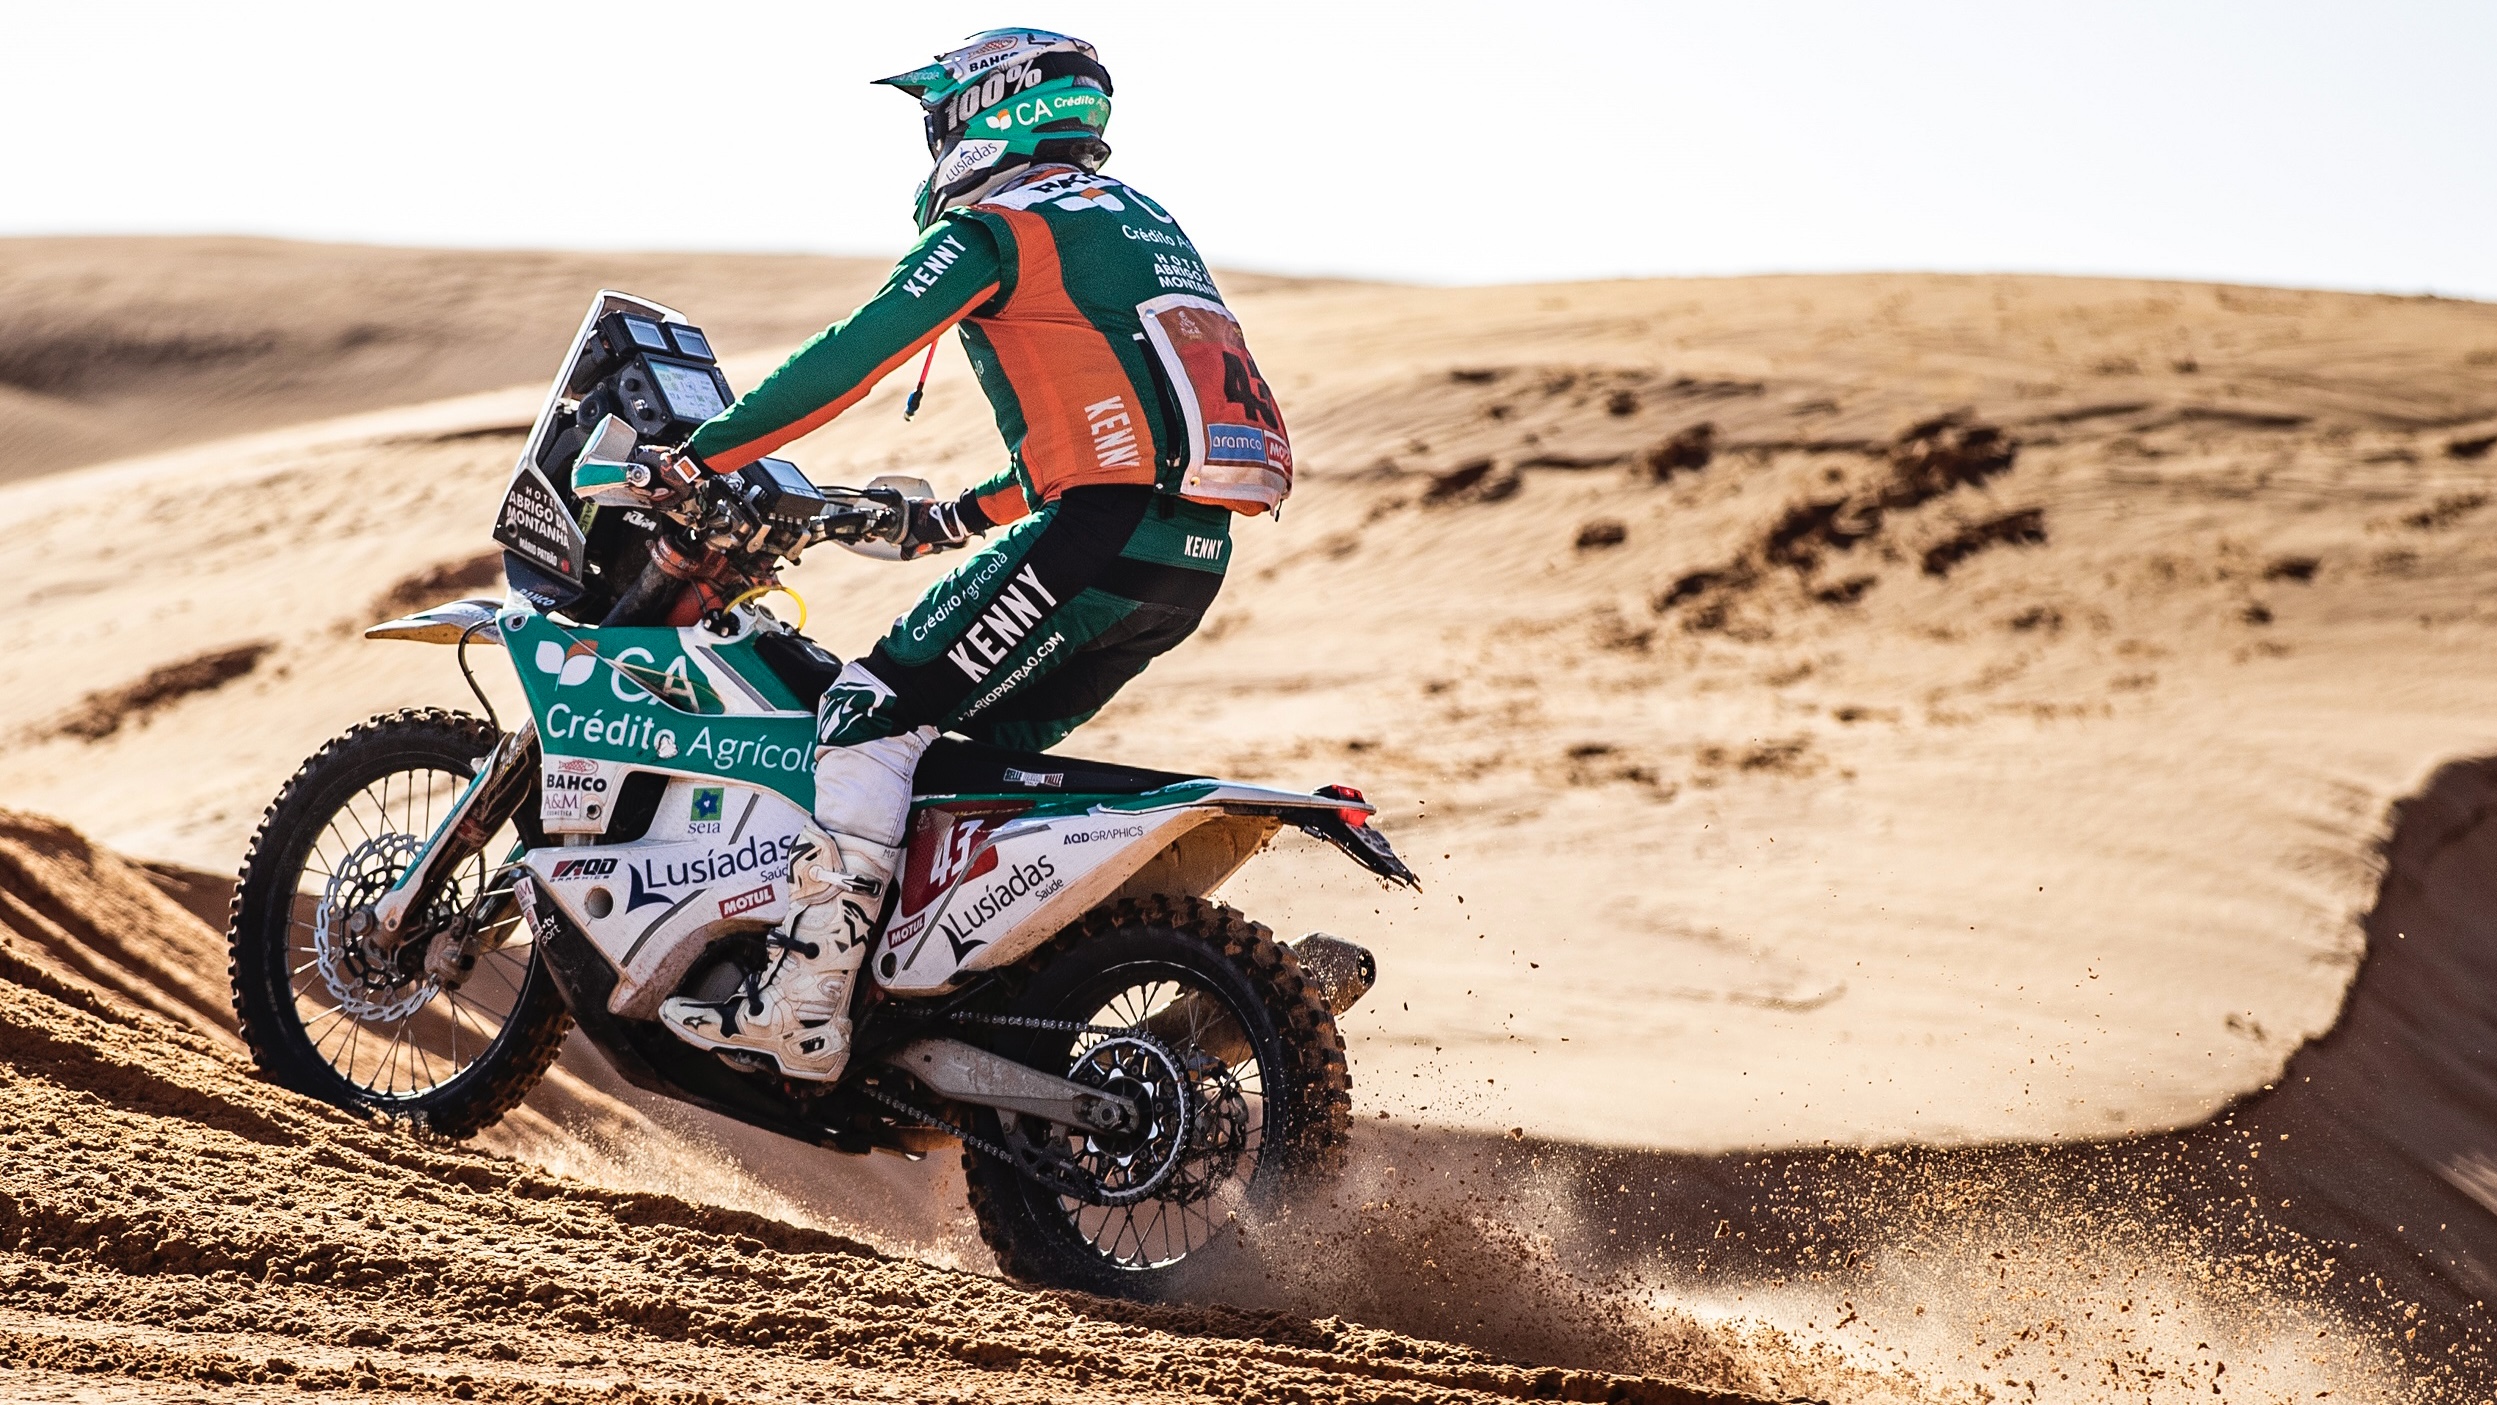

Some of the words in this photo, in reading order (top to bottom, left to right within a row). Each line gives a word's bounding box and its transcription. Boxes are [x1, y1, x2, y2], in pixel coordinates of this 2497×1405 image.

[969, 51, 1019, 72] BAHC
[945, 57, 1042, 131] 100%
[1015, 98, 1054, 126] CA
[1053, 95, 1095, 109] Crédito
[1121, 224, 1176, 247] Crédito
[902, 234, 967, 299] KENNY
[1154, 263, 1204, 282] ABRIGO
[1212, 435, 1263, 451] aramco
[525, 485, 560, 511] HOTEL
[508, 490, 553, 523] ABRIGO
[555, 513, 568, 534] DA
[622, 510, 657, 532] KTM
[506, 504, 570, 550] MONTANHA
[1184, 534, 1225, 560] KENNY
[912, 594, 962, 642] Crédito
[947, 562, 1058, 684] KENNY
[610, 646, 700, 714] CA
[546, 702, 678, 757] Crédito
[546, 774, 607, 792] BAHCO
[544, 792, 579, 810] A&M
[646, 835, 791, 889] Lusíadas
[930, 820, 985, 887] 43
[560, 858, 620, 877] AQD
[760, 864, 789, 883] Saúd
[723, 888, 773, 915] MOTUL
[947, 854, 1055, 939] Lusíadas
[1034, 877, 1065, 902] Saúde
[541, 923, 561, 947] port
[890, 914, 924, 946] MOTUL
